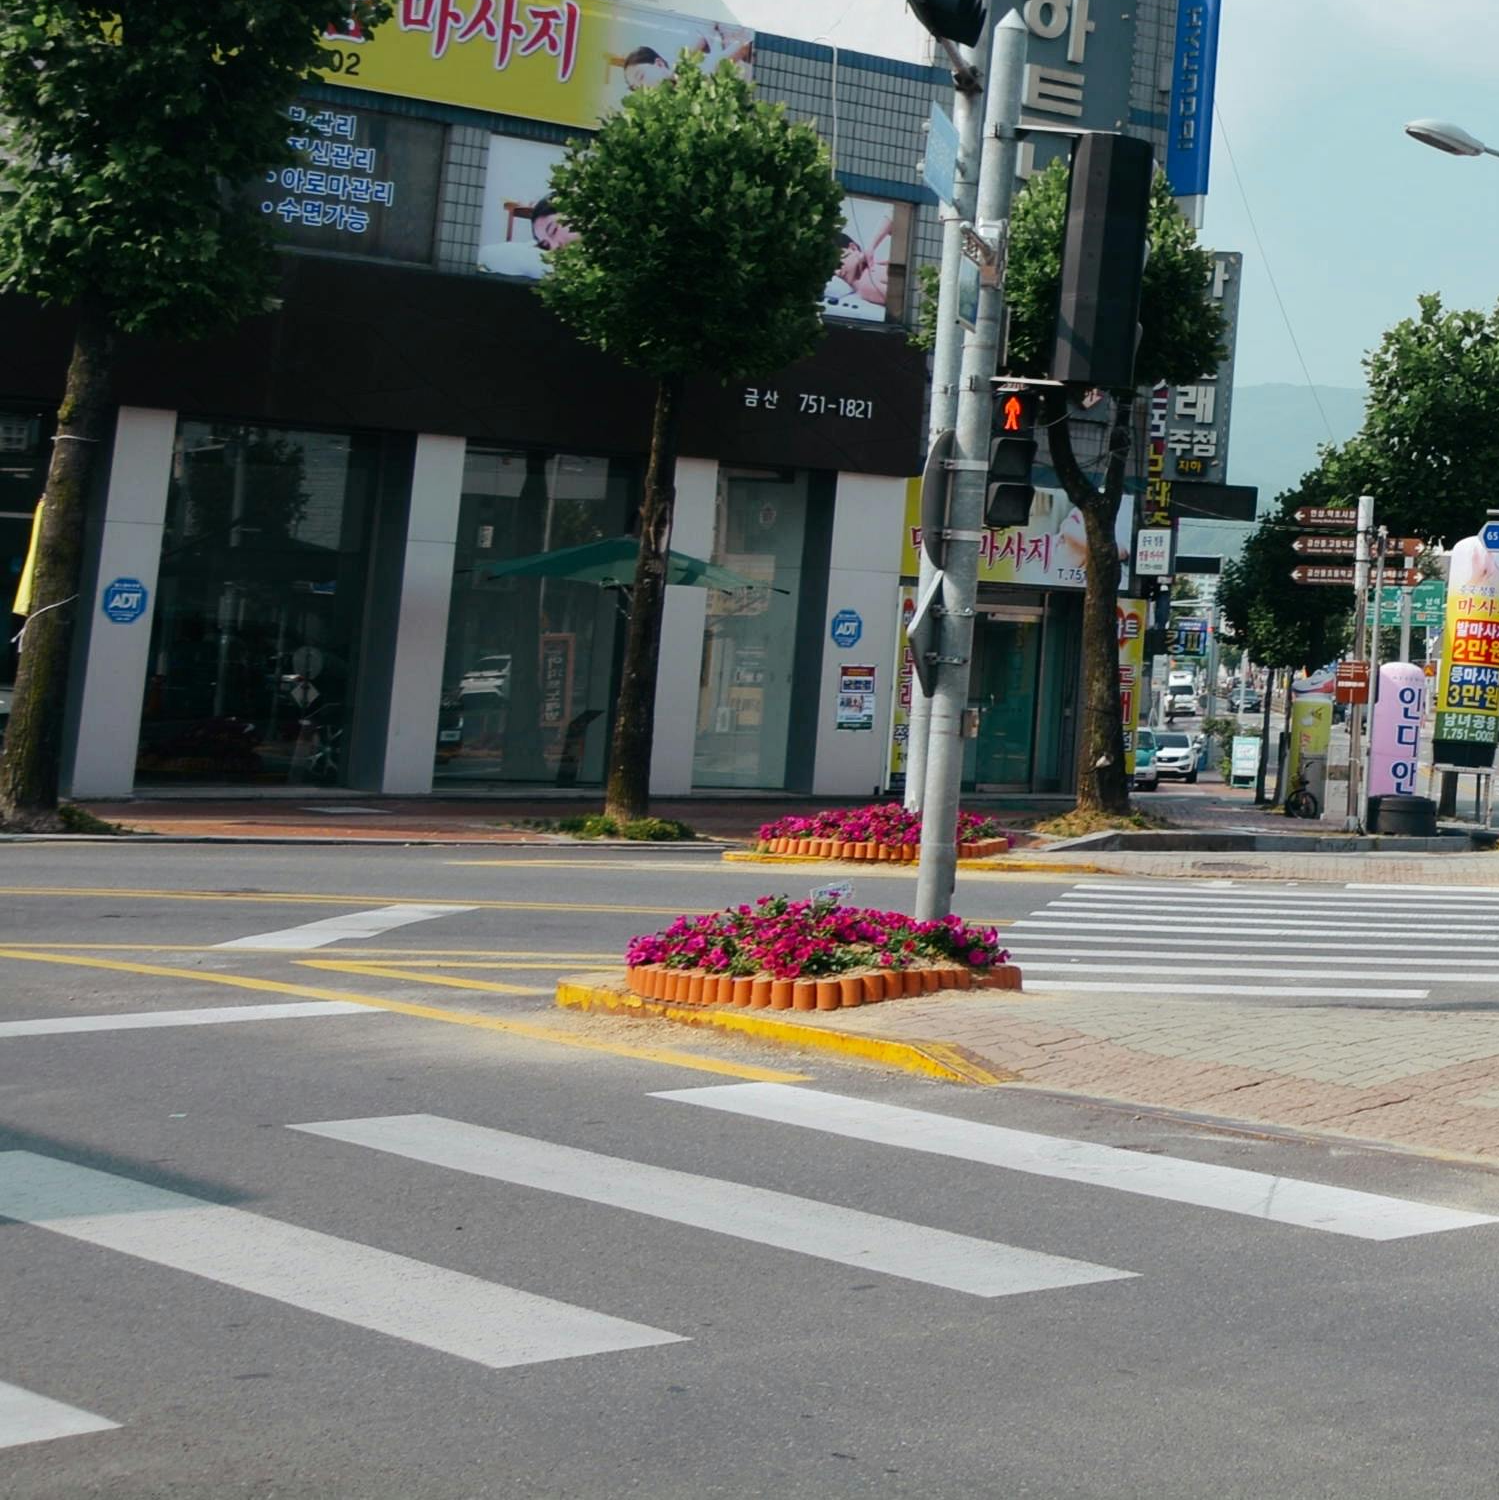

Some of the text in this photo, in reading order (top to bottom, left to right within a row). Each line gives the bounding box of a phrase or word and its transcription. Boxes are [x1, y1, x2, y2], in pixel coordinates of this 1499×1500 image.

[1177, 6, 1203, 149] HYUNDAI
[281, 168, 394, 206] 아로마관리
[277, 197, 370, 233] 수면가능
[744, 387, 873, 419] 금산 751-1821
[1168, 428, 1217, 457] 주점
[1487, 532, 1499, 541] 65
[110, 593, 142, 609] ADT
[836, 622, 858, 635] ADT
[1448, 684, 1499, 708] 3만원
[1391, 687, 1422, 795] 인디안
